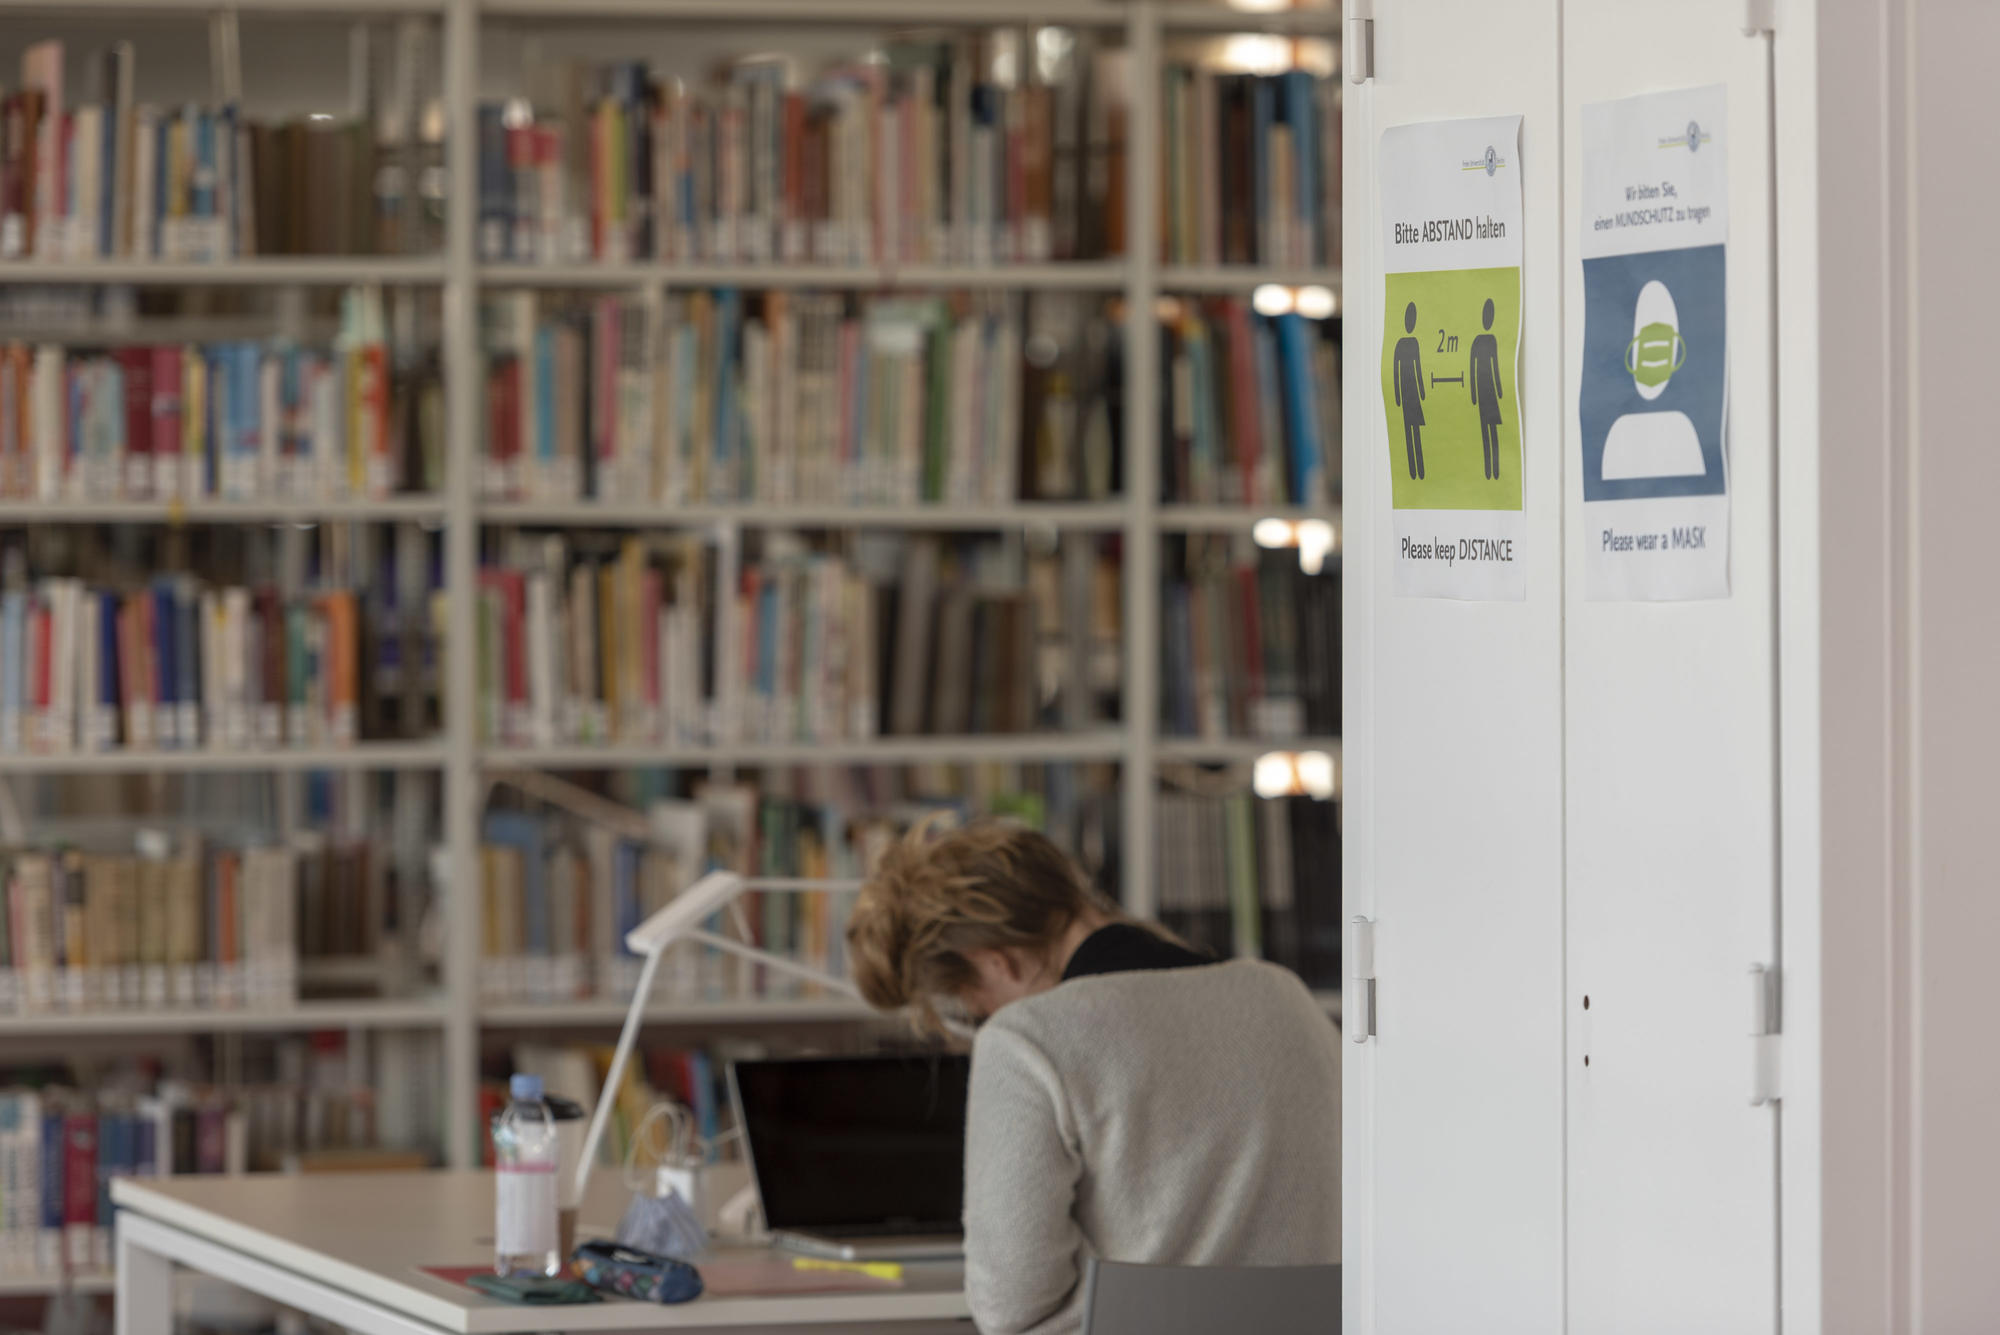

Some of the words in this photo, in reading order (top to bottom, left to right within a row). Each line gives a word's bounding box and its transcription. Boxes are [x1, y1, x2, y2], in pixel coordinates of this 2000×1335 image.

[1625, 186, 1637, 201] Wir
[1662, 181, 1678, 199] Sie,
[1395, 222, 1420, 244] Bitte
[1422, 219, 1473, 242] ABSTAND
[1476, 215, 1506, 239] halten
[1594, 215, 1614, 231] einen
[1615, 206, 1674, 227] MUNDSCHUTZ
[1675, 209, 1686, 222] zu
[1687, 205, 1711, 224] tragen
[1401, 535, 1433, 560] Please
[1434, 536, 1456, 567] keep
[1458, 538, 1513, 561] DISTANCE
[1602, 529, 1634, 552] Please
[1636, 533, 1658, 551] wear
[1661, 536, 1668, 550] a
[1672, 527, 1706, 549] MASK
